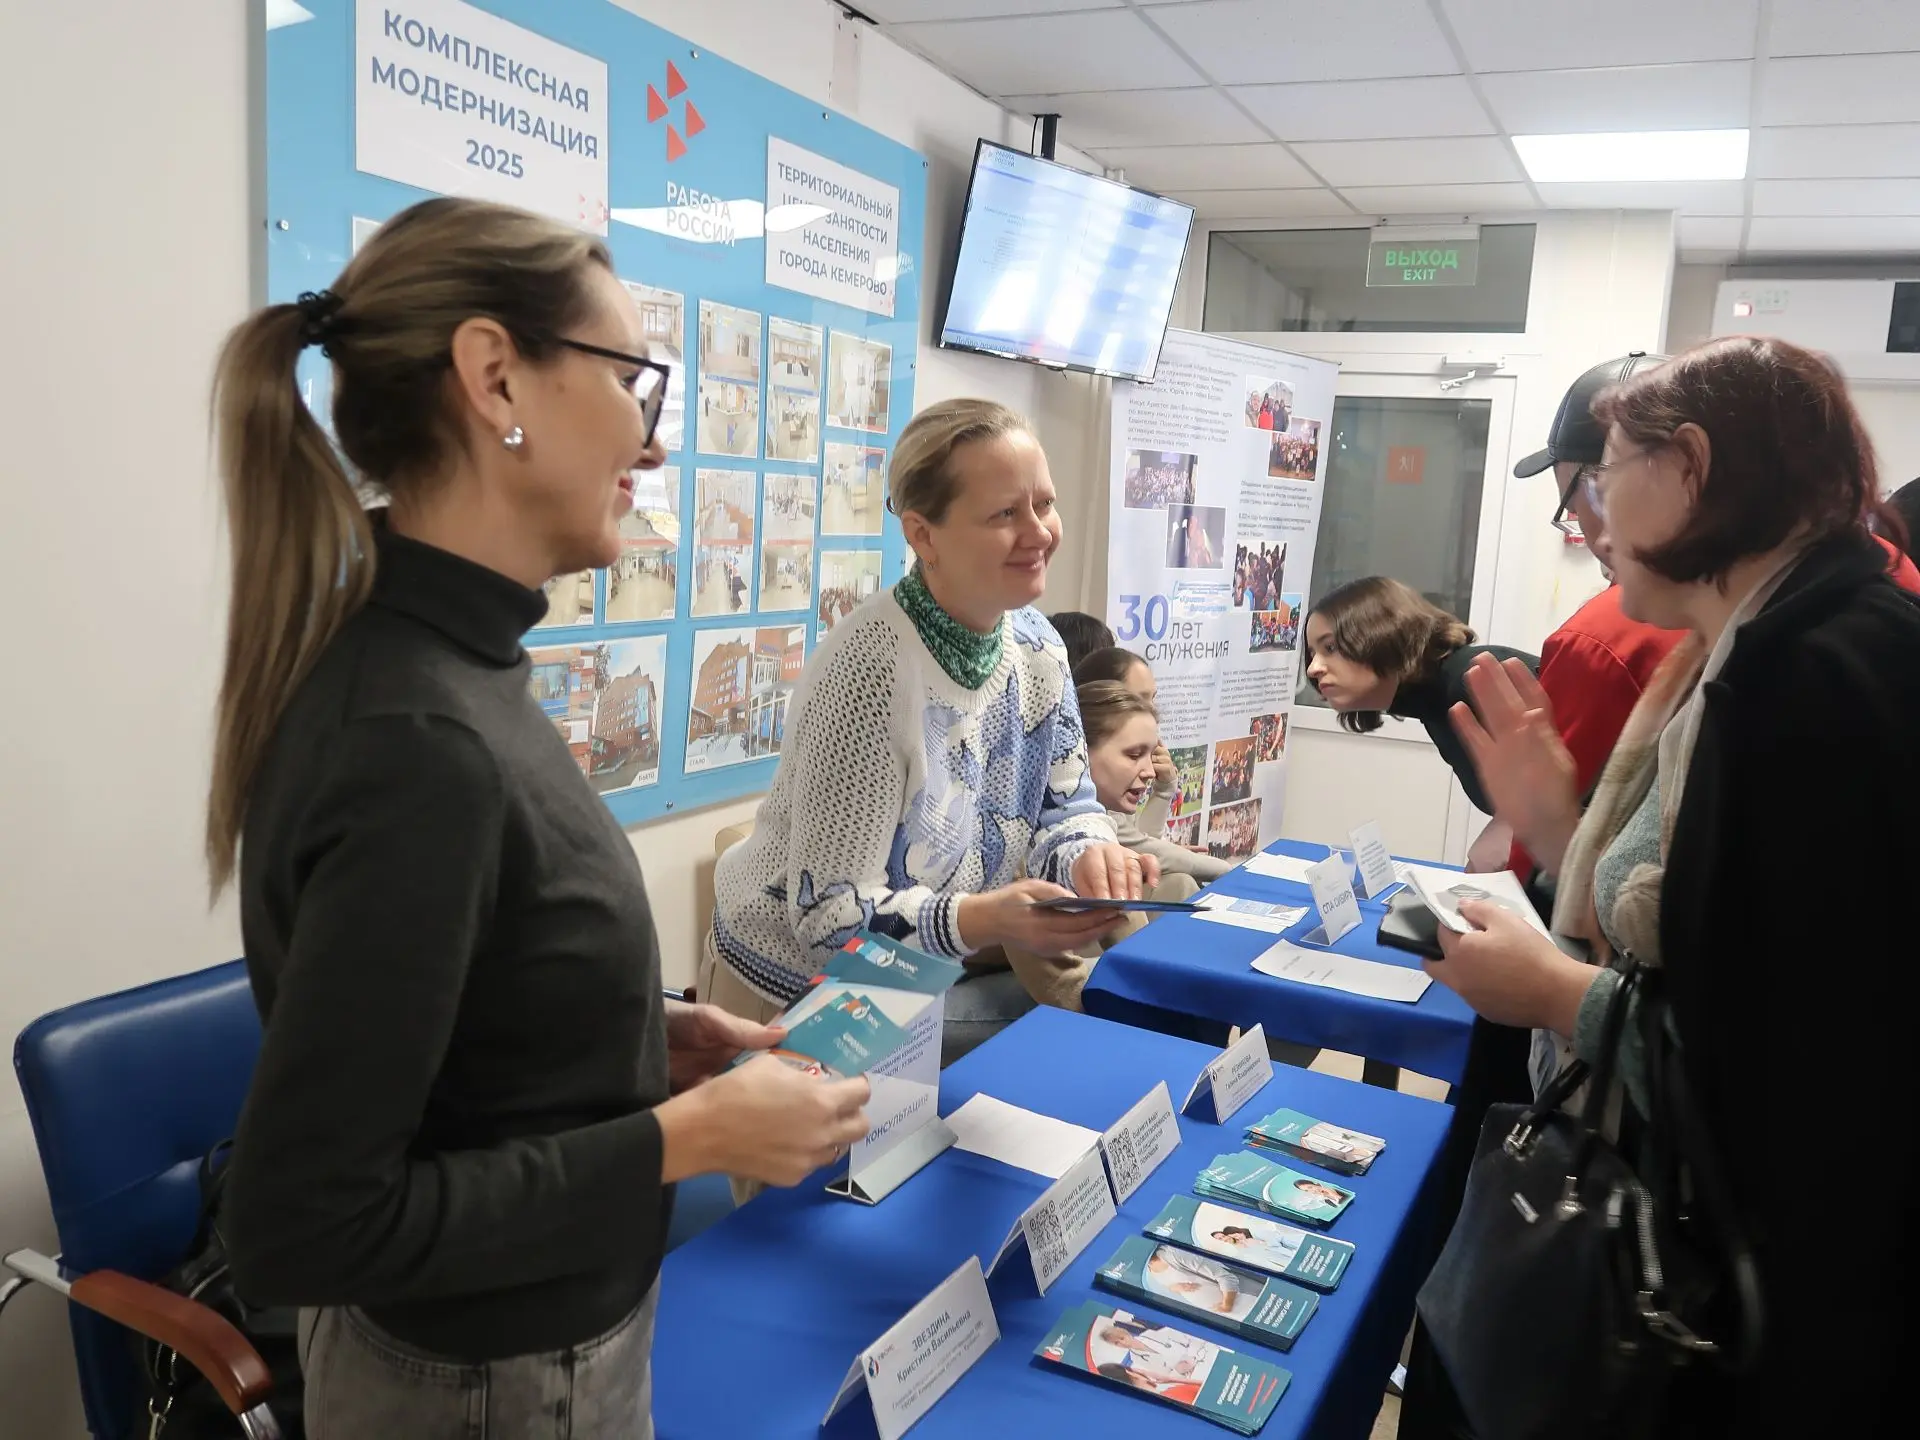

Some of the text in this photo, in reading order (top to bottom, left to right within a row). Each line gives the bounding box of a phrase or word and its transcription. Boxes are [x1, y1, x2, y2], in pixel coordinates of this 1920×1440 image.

[384, 8, 590, 113] КОМПЛЕКСНАЯ
[371, 55, 599, 160] МОДЕРНИЗАЦИЯ
[465, 138, 524, 179] 2025
[666, 180, 732, 222] РАБОТА
[777, 161, 893, 221] ТЕРРИТОРИАЛЬНЫЙ
[666, 208, 736, 248] РОССИИ
[803, 227, 871, 265] НАСЕЛЕНИЯ
[824, 210, 889, 246] ЗАНЯТОСТИ
[778, 249, 888, 296] ГОРОДА КЕМЕРОВО
[1385, 249, 1459, 269] ВЫХОД
[1403, 268, 1437, 281] EXIT
[1117, 594, 1169, 641] 30
[1169, 621, 1204, 640] лет
[1145, 640, 1230, 667] служения
[864, 1093, 930, 1148] КОНСУЛЬТАЦИЯ
[896, 1347, 932, 1384] Кристина
[930, 1309, 972, 1352] Васильевна
[912, 1310, 951, 1352] ЗВЕЗДИНА
